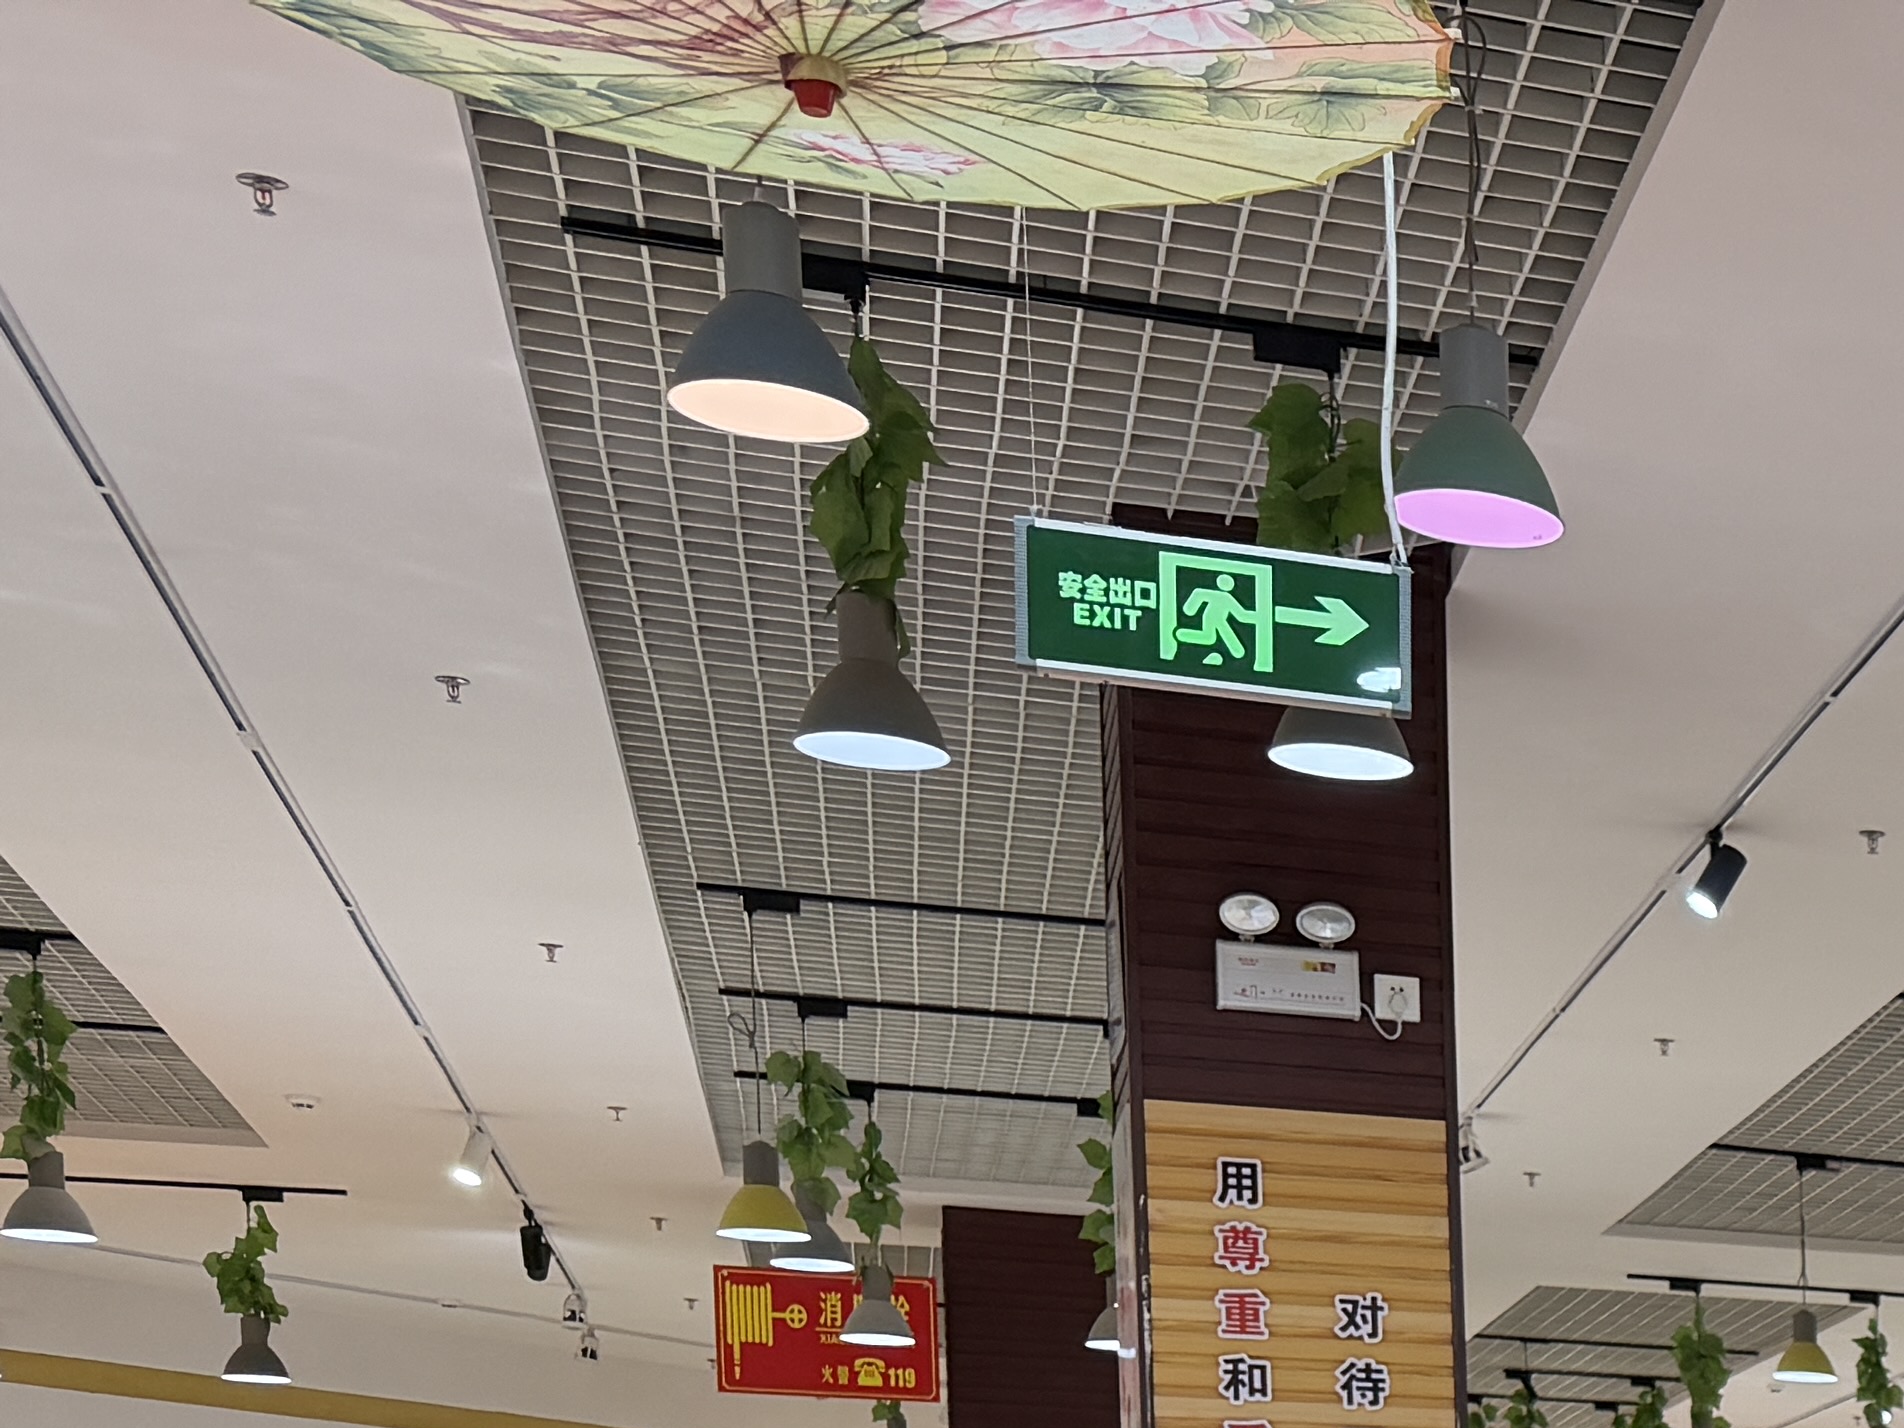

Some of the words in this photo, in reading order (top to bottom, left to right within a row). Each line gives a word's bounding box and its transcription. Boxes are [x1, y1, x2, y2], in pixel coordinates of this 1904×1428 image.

[1058, 570, 1158, 609] 安全出口
[1073, 602, 1142, 631] EXIT
[888, 1368, 915, 1388] 119
